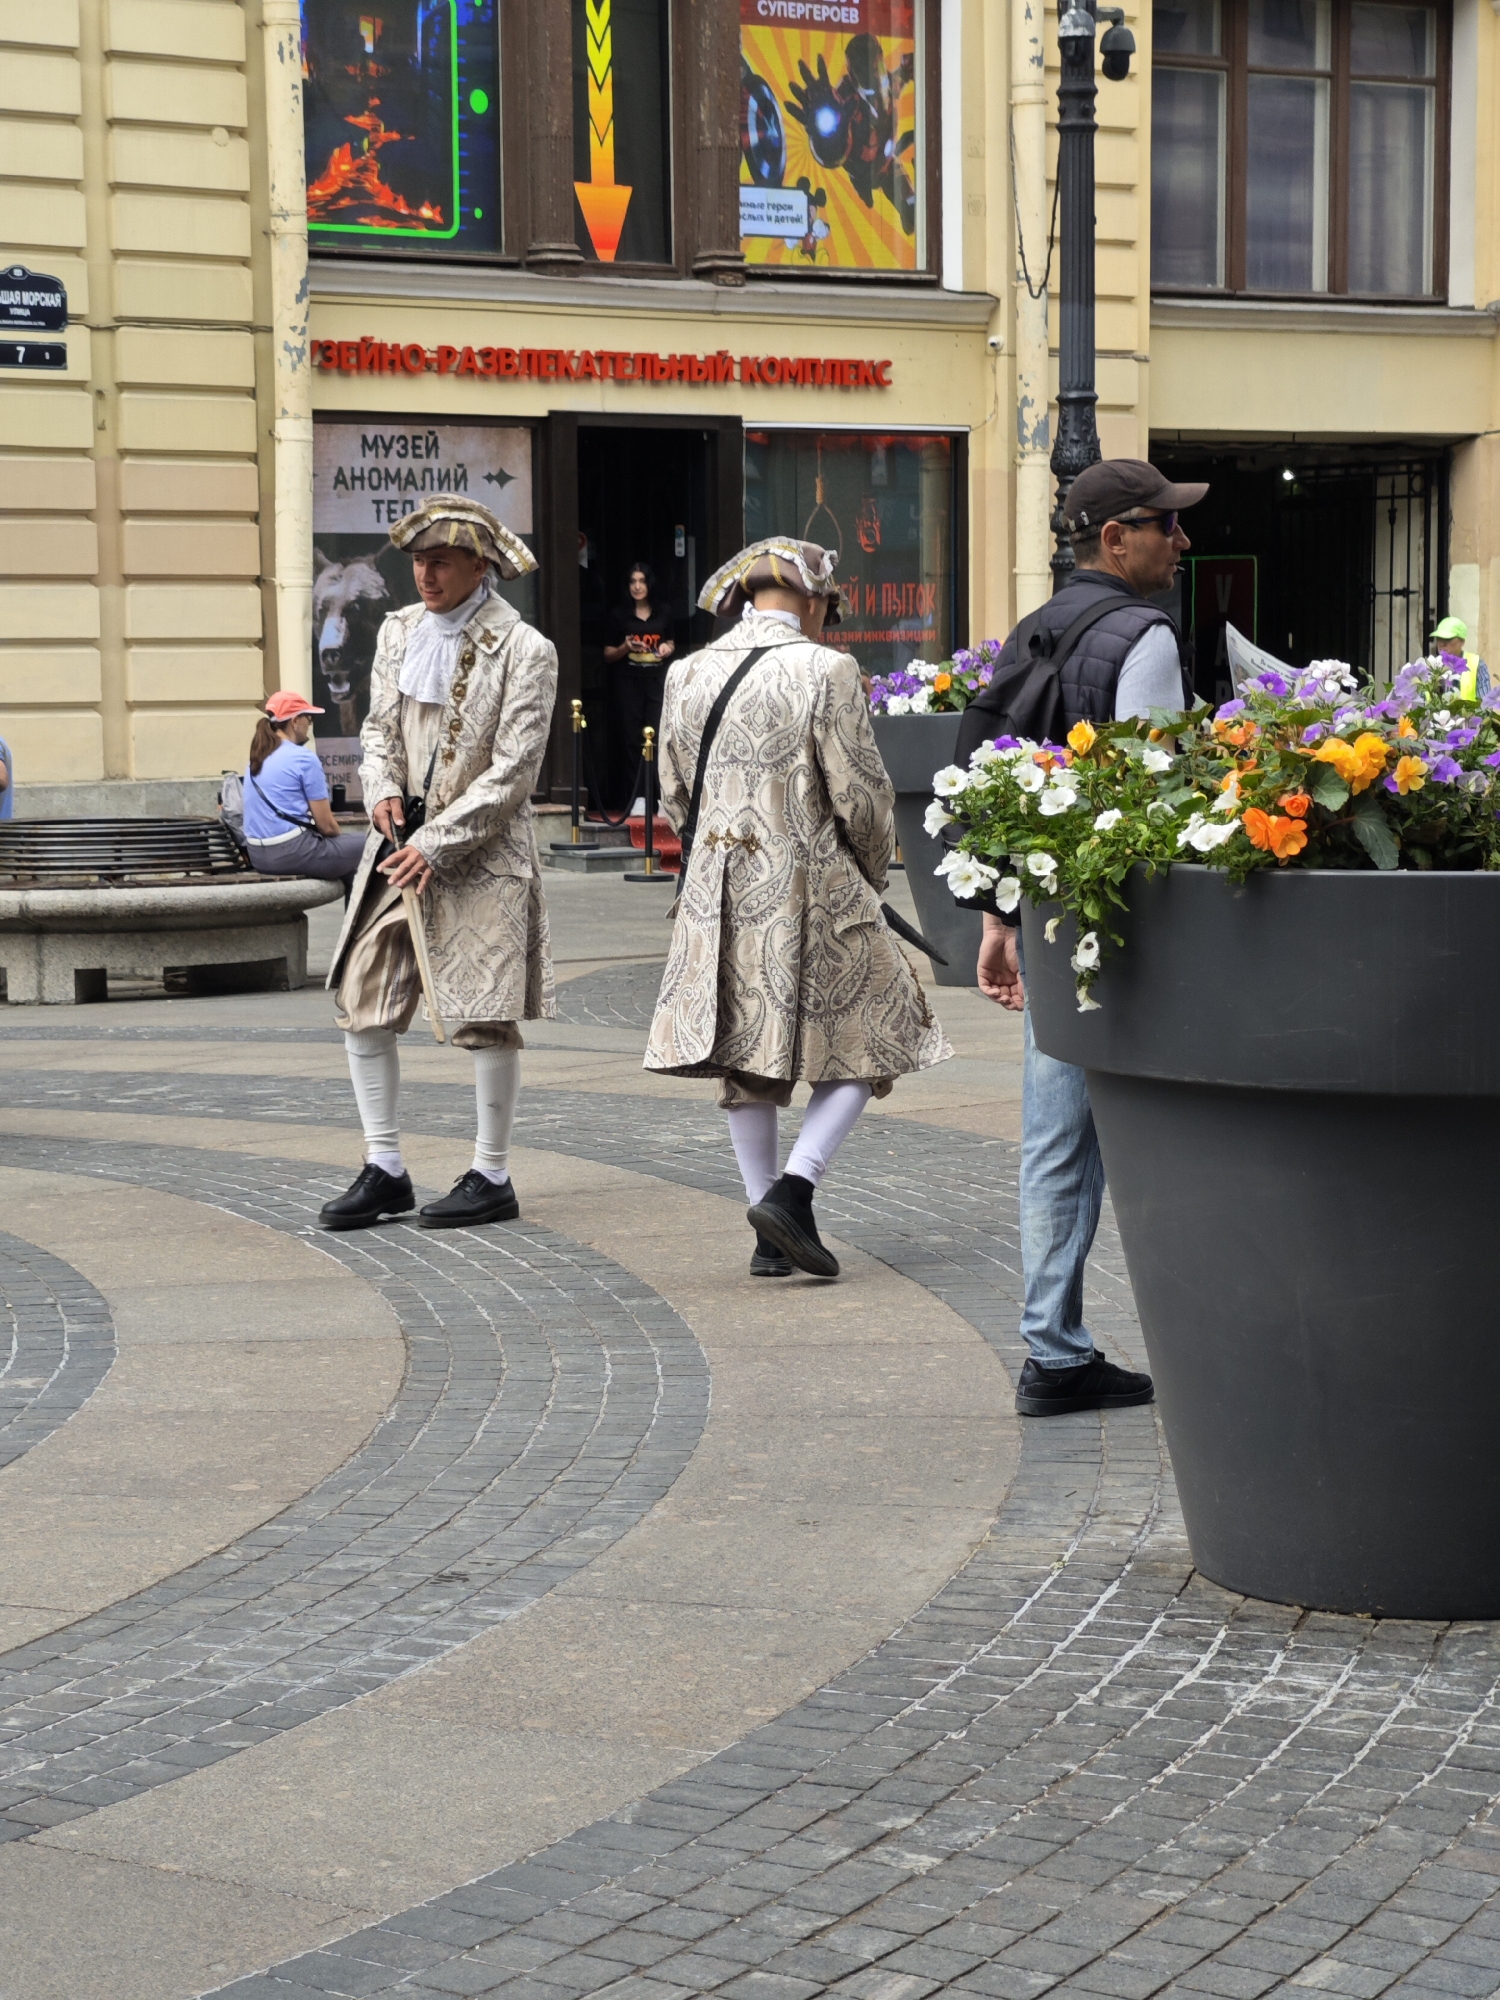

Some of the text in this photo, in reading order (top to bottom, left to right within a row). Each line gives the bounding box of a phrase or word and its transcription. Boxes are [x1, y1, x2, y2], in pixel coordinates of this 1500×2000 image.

[757, 0, 860, 24] СУПЕРГЕРОЕВ
[21, 291, 62, 308] МОРСКАЯ
[9, 307, 31, 317] УЛИЦА
[16, 346, 26, 363] 7
[740, 355, 893, 387] КОМПЛЕКС
[361, 430, 440, 460] МУЗЕЙ
[332, 463, 469, 492] АНОМАЛИЙ
[865, 583, 877, 617] И
[881, 582, 936, 618] ПЫТОК
[826, 630, 862, 644] КАЗНИ
[863, 630, 936, 643] ИНКВИЗИЦИИ
